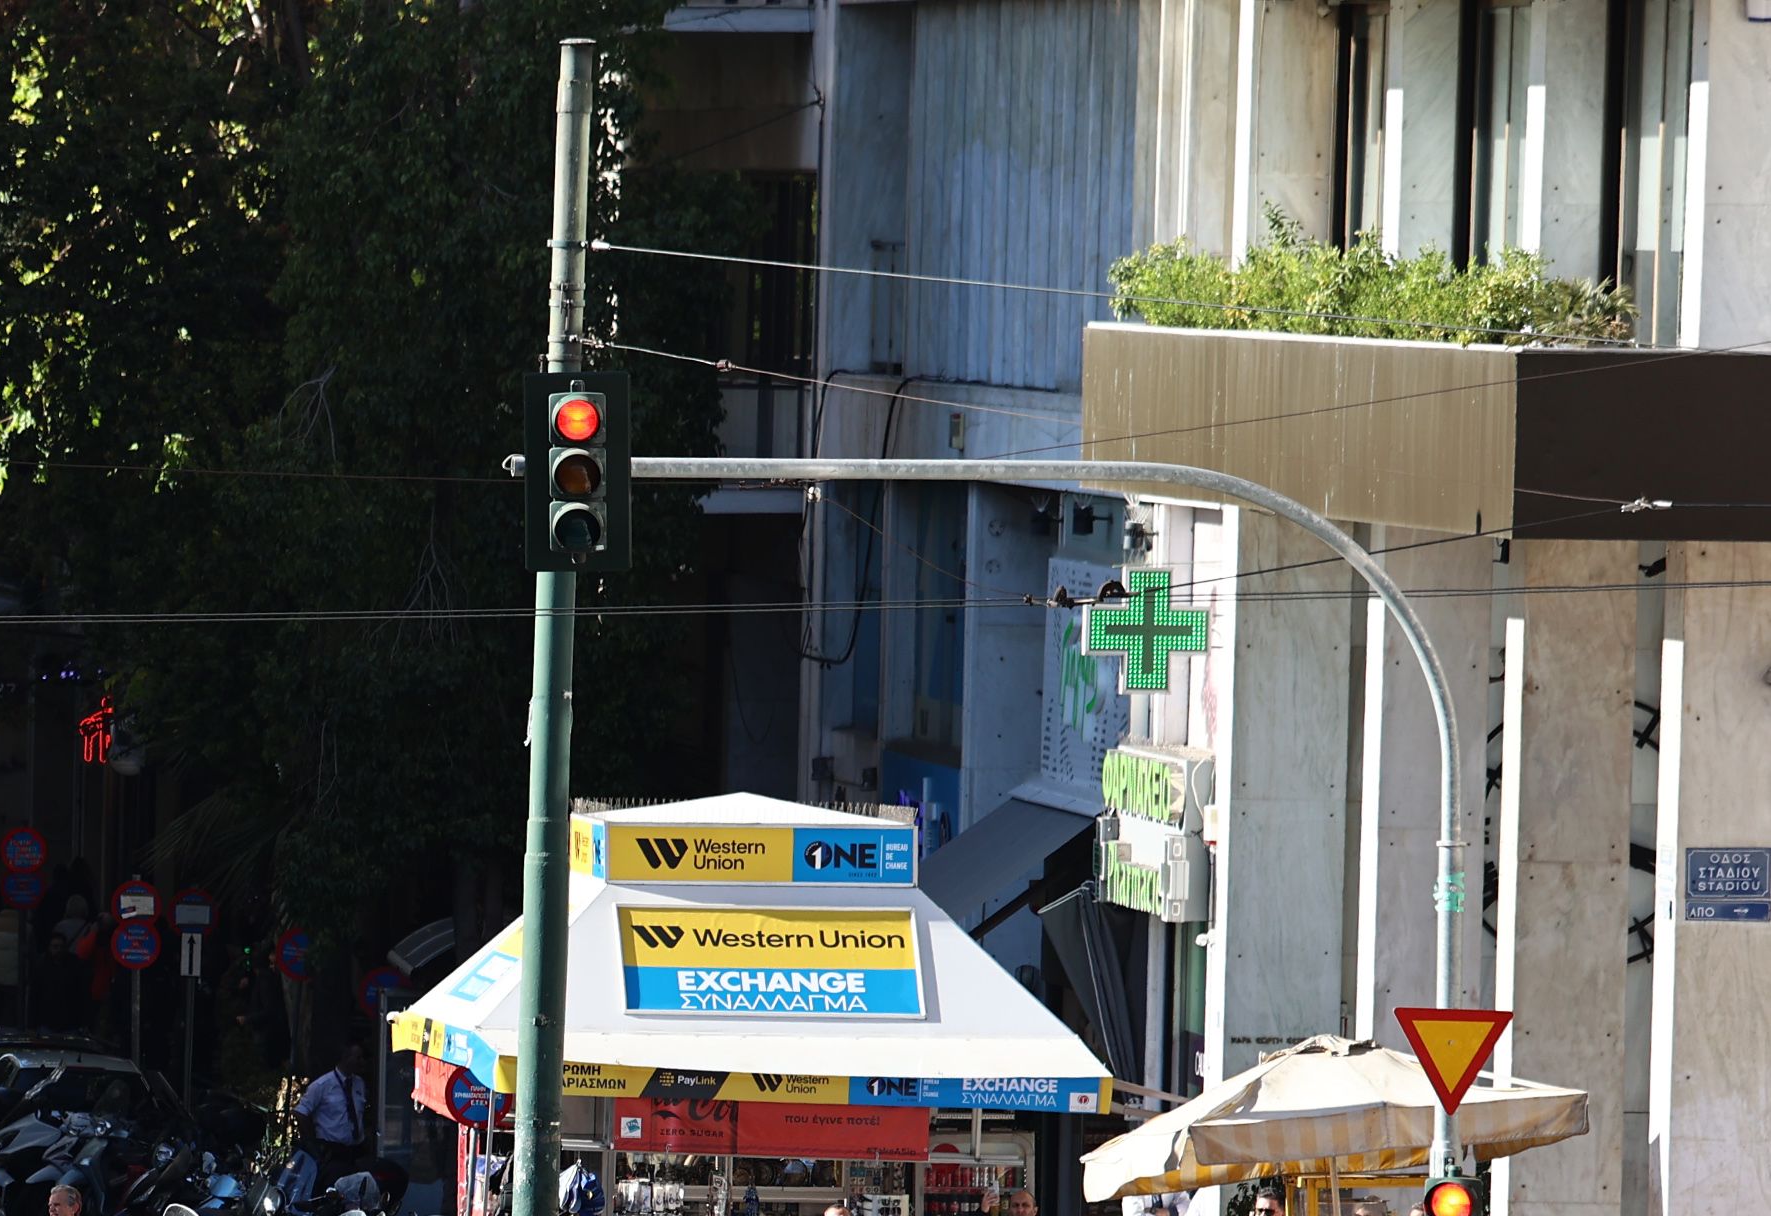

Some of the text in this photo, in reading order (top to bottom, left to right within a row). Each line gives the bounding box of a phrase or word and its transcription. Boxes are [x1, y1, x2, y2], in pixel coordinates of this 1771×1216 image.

[693, 838, 766, 855] Western
[693, 856, 745, 871] Union
[1709, 853, 1751, 864] ΟΔΟΣ
[1698, 866, 1761, 879] ΣΤΑΔΙΟΥ
[1697, 881, 1761, 892] STADIOU
[1689, 906, 1715, 918] ΑΠΟ
[692, 928, 905, 949] Western Union
[677, 970, 867, 993] EXCHANGE
[679, 993, 868, 1012] ΣΥΝΑΛΛΑΓΜΑ
[677, 1075, 717, 1087] PayLink
[785, 1074, 830, 1085] Western
[961, 1078, 1058, 1093] EXCHANGE
[785, 1084, 817, 1095] Union
[961, 1093, 1057, 1107] ΣΥΝΑΛΛΑΓΜΑ
[784, 1114, 880, 1126] που έγινε ποτέ!
[659, 1128, 724, 1138] ZERO SUGAR
